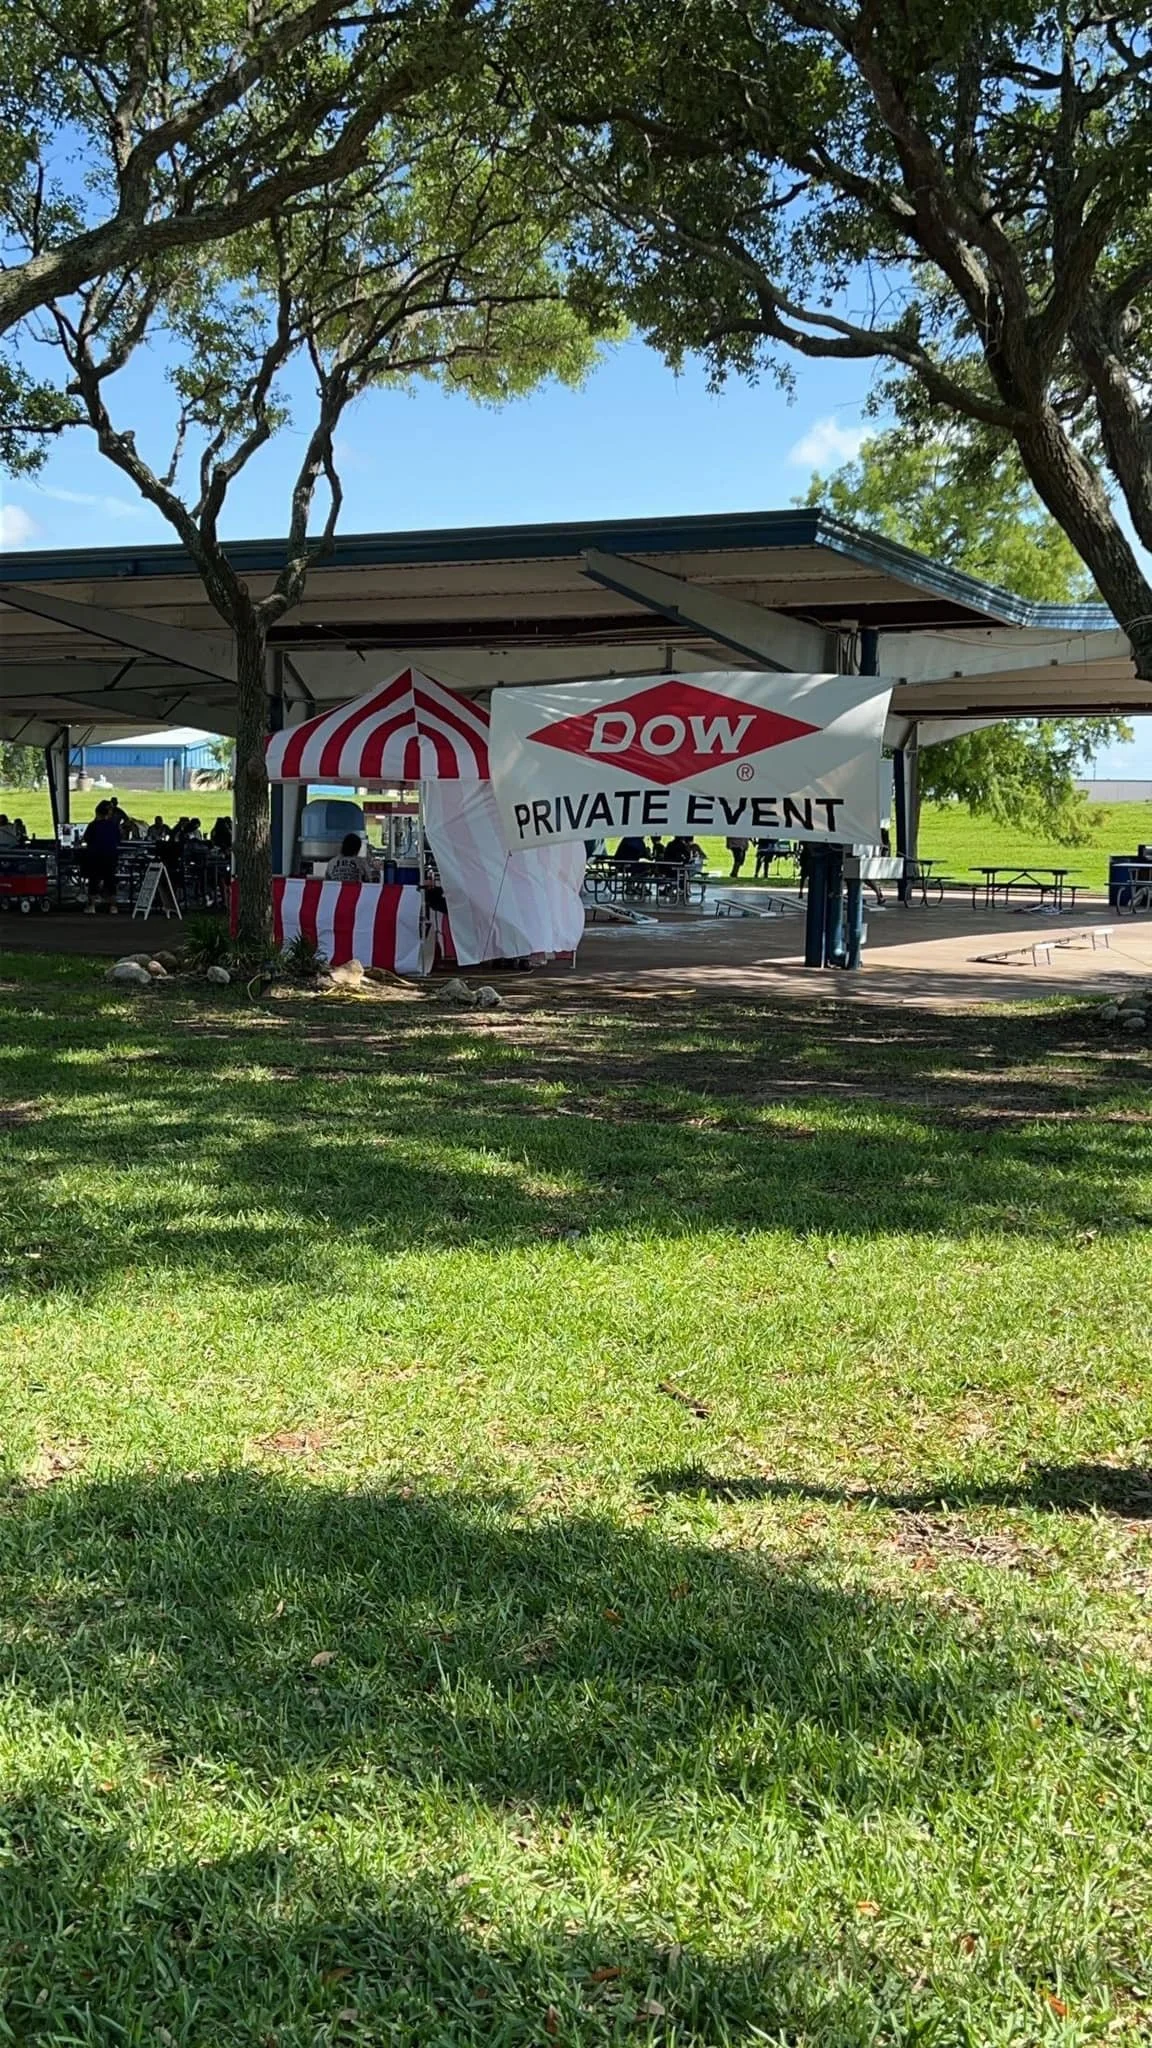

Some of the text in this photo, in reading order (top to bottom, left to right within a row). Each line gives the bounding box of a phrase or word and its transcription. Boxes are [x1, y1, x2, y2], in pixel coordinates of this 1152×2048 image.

[587, 711, 757, 755] DOW
[515, 790, 844, 839] PRIVATE EVENT
